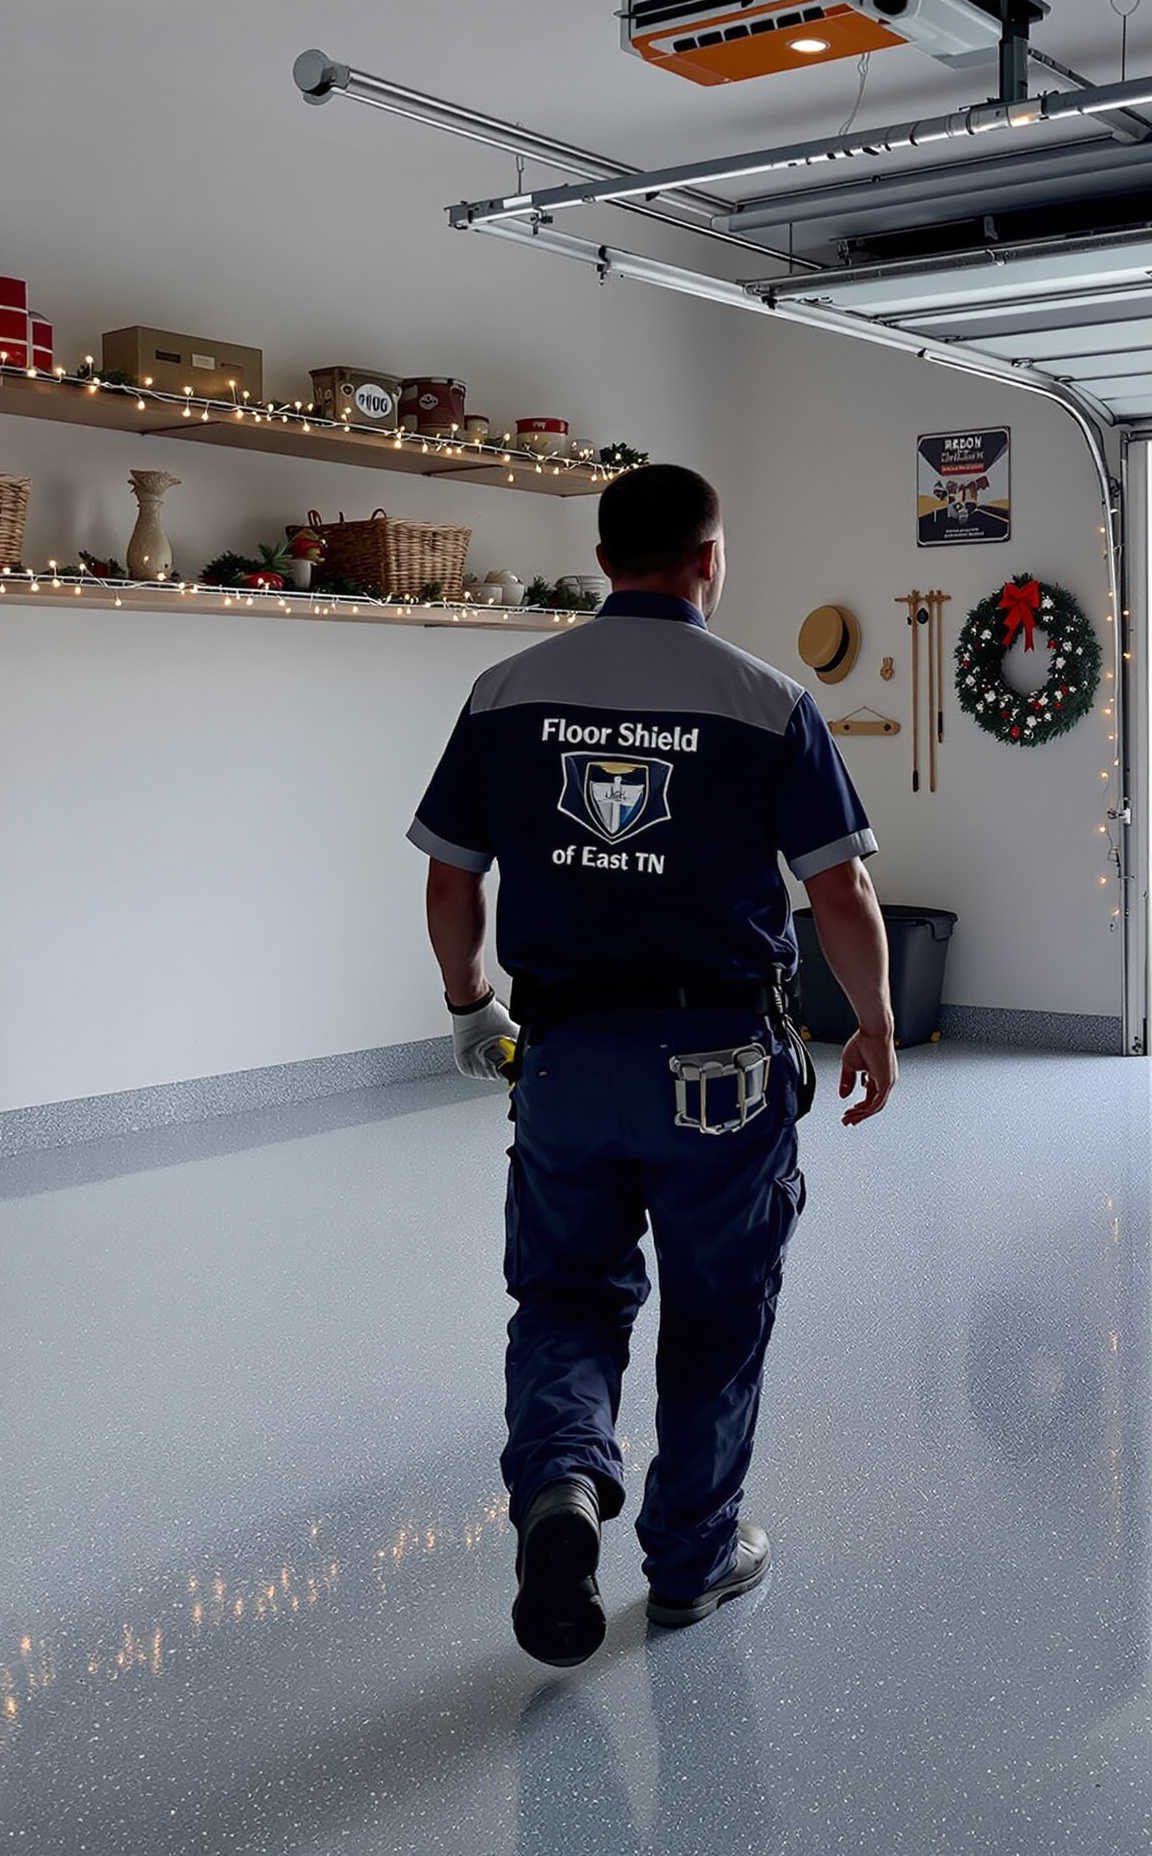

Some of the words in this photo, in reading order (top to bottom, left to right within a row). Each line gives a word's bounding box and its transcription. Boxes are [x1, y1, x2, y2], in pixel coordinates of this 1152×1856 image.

[541, 718, 612, 745] Floor
[618, 722, 699, 752] Shield
[552, 845, 577, 865] of
[581, 846, 628, 871] East
[635, 852, 665, 874] TN
